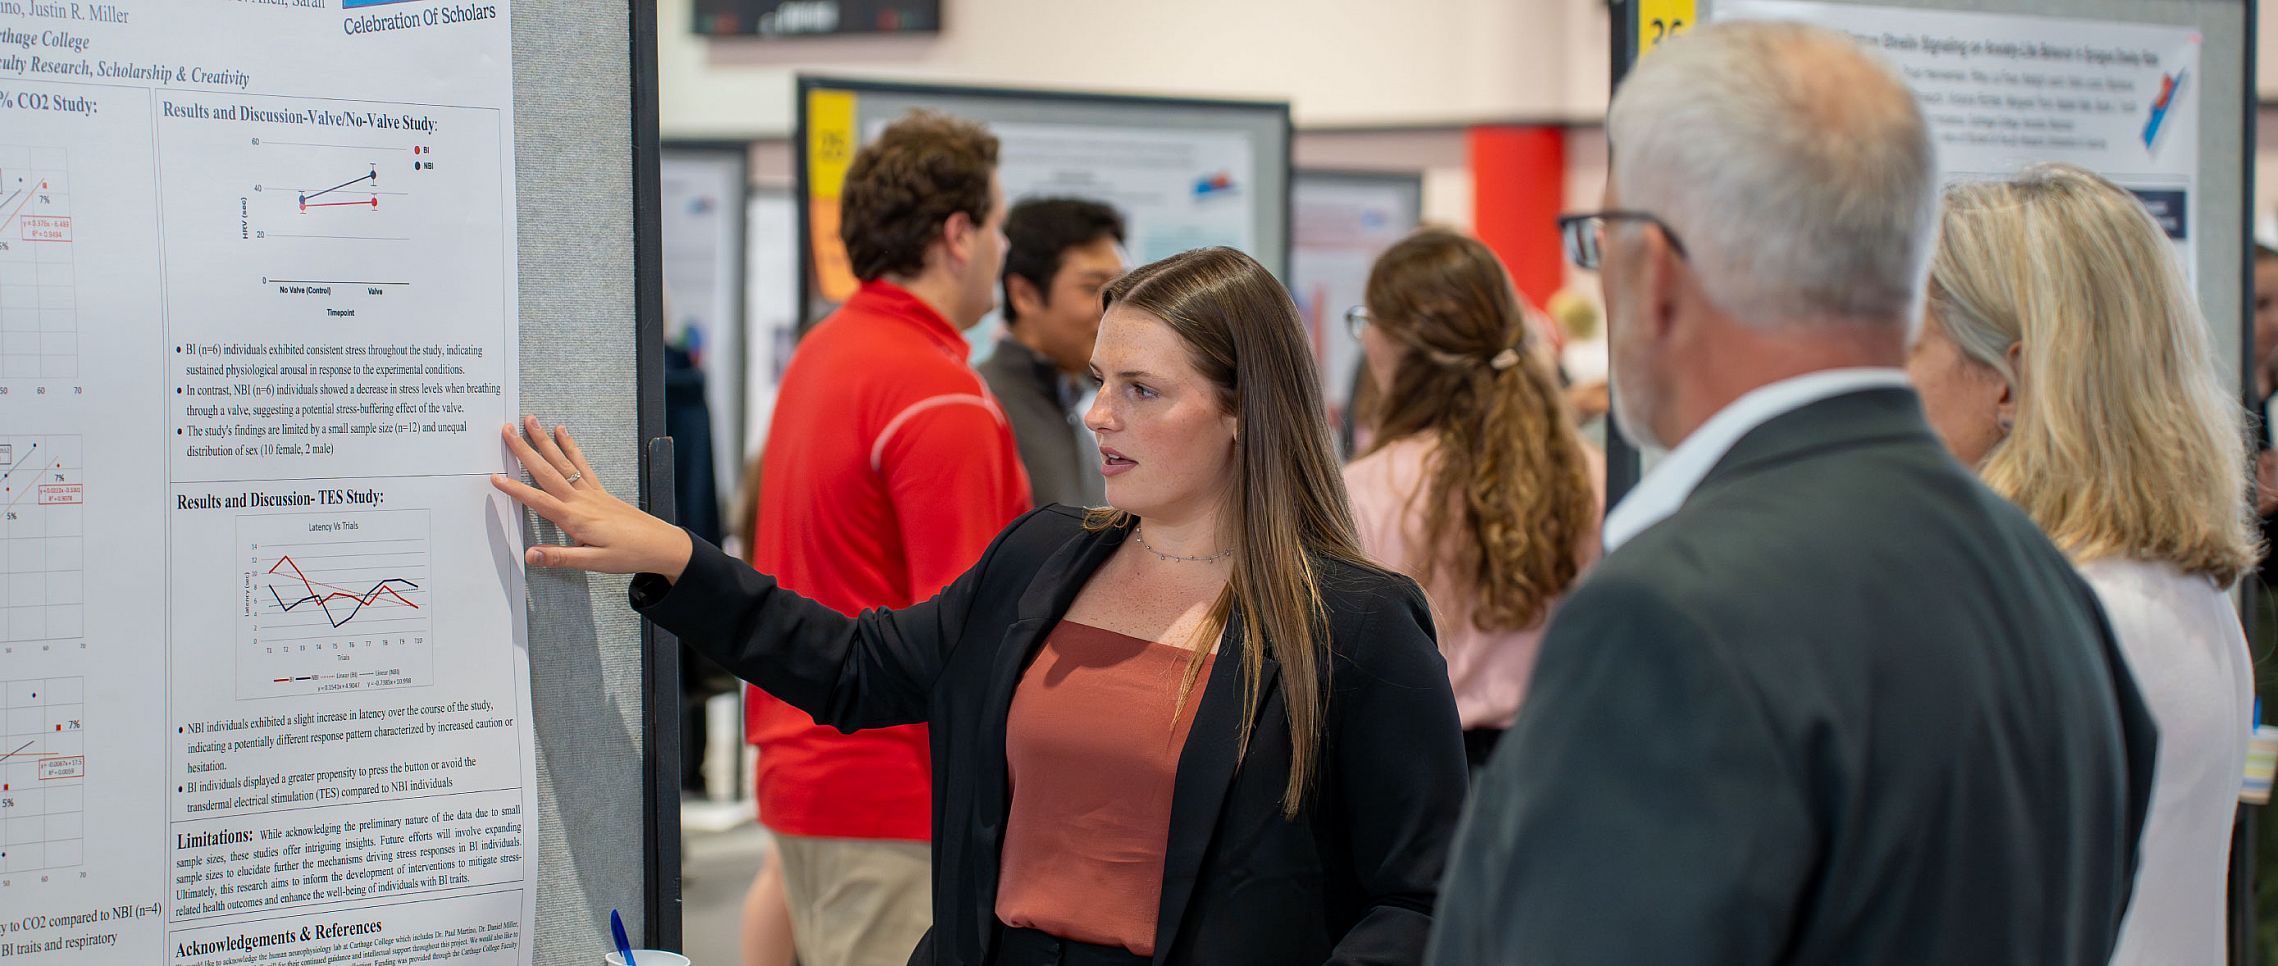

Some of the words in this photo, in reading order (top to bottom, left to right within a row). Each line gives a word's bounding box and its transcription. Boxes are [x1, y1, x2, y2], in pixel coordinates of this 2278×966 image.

[29, 0, 66, 18] Justin
[70, 2, 85, 20] R.
[89, 4, 128, 23] Miller
[343, 13, 420, 34] Celebration
[422, 7, 438, 25] Of
[441, 3, 496, 23] Scholars
[0, 27, 37, 49] thage
[41, 30, 89, 52] College
[30, 55, 93, 76] Research,
[96, 60, 172, 84] Scholarship
[175, 65, 186, 81] &
[191, 66, 249, 89] Creativity
[17, 92, 49, 109] CO2
[52, 94, 98, 117] Study:
[163, 101, 209, 118] Results
[212, 104, 236, 120] and
[239, 105, 400, 128] Discussion-Valve/No-Valve
[401, 114, 438, 135] Study:
[252, 138, 260, 146] 60
[256, 231, 265, 239] 20
[326, 308, 355, 317] Timepoint
[185, 343, 196, 354] BI
[197, 343, 222, 356] (n=6)
[223, 343, 267, 354] individuals
[268, 343, 305, 354] exhibited
[305, 344, 343, 355] consistent
[344, 346, 366, 355] stress
[367, 344, 408, 357] throughout
[408, 344, 421, 355] the
[422, 343, 445, 358] study,
[445, 344, 483, 357] indicating
[185, 363, 224, 375] sustained
[225, 363, 278, 377] physiological
[279, 363, 308, 374] arousal
[309, 364, 317, 374] in
[318, 366, 352, 377] response
[352, 365, 361, 374] to
[362, 363, 374, 374] the
[375, 363, 423, 377] experimental
[424, 363, 465, 374] conditions.
[186, 384, 195, 395] In
[196, 386, 232, 397] contrast,
[233, 383, 251, 395] NBI
[252, 383, 275, 397] (n=6)
[276, 383, 318, 394] individuals
[319, 383, 349, 394] showed
[349, 386, 355, 394] a
[355, 383, 388, 394] decrease
[389, 383, 397, 394] in
[398, 385, 420, 394] stress
[421, 382, 443, 393] levels
[444, 382, 465, 393] when
[465, 382, 501, 395] breathing
[186, 404, 218, 418] through
[219, 407, 225, 415] a
[227, 404, 251, 417] valve,
[252, 404, 294, 417] suggesting
[294, 406, 300, 414] a
[301, 403, 335, 417] potential
[335, 402, 394, 416] stress-buffering
[395, 402, 417, 413] effect
[417, 402, 427, 413] of
[427, 402, 440, 413] the
[441, 401, 464, 412] valve.
[187, 424, 203, 436] The
[204, 424, 232, 438] study's
[234, 424, 266, 438] findings
[267, 426, 280, 435] are
[281, 423, 309, 434] limited
[309, 423, 320, 437] by
[321, 425, 327, 434] a
[327, 422, 349, 433] small
[350, 422, 377, 436] sample
[378, 423, 393, 433] size
[394, 421, 421, 434] (n=12)
[421, 421, 436, 432] and
[437, 420, 467, 434] unequal
[177, 493, 221, 509] Results
[224, 492, 247, 508] and
[250, 492, 315, 506] Discussion-
[318, 489, 343, 504] TES
[346, 488, 384, 507] Study:
[308, 523, 332, 532] Latency
[332, 521, 341, 530] Vs
[342, 520, 359, 529] Trials
[187, 722, 204, 733] NBI
[206, 718, 249, 732] individuals
[249, 715, 286, 728] exhibited
[286, 717, 292, 725] a
[293, 713, 315, 726] slight
[316, 712, 347, 722] increase
[348, 712, 357, 720] in
[358, 708, 386, 720] latency
[387, 708, 405, 717] over
[406, 704, 419, 715] the
[419, 705, 445, 714] course
[446, 701, 455, 712] of
[456, 700, 469, 711] the
[470, 699, 494, 712] study,
[177, 830, 253, 849] Limitations:
[259, 828, 282, 839] While
[284, 823, 341, 837] acknowledging
[343, 820, 356, 831] the
[358, 817, 402, 832] preliminary
[404, 816, 428, 825] nature
[431, 811, 440, 822] of
[442, 811, 454, 821] the
[456, 809, 473, 819] data
[474, 807, 488, 818] due
[490, 808, 499, 816] to
[501, 804, 521, 815] small
[9, 921, 20, 932] to
[22, 915, 46, 930] CO2
[48, 909, 98, 928] compared
[99, 911, 110, 921] to
[112, 905, 133, 919] NBI
[134, 902, 162, 919] (n=4)
[1, 942, 14, 956] BI
[16, 940, 42, 954] traits
[44, 936, 63, 951] and
[64, 933, 117, 950] respiratory
[176, 931, 296, 958] Acknowledgements
[299, 926, 311, 941] &
[315, 921, 382, 939] References
